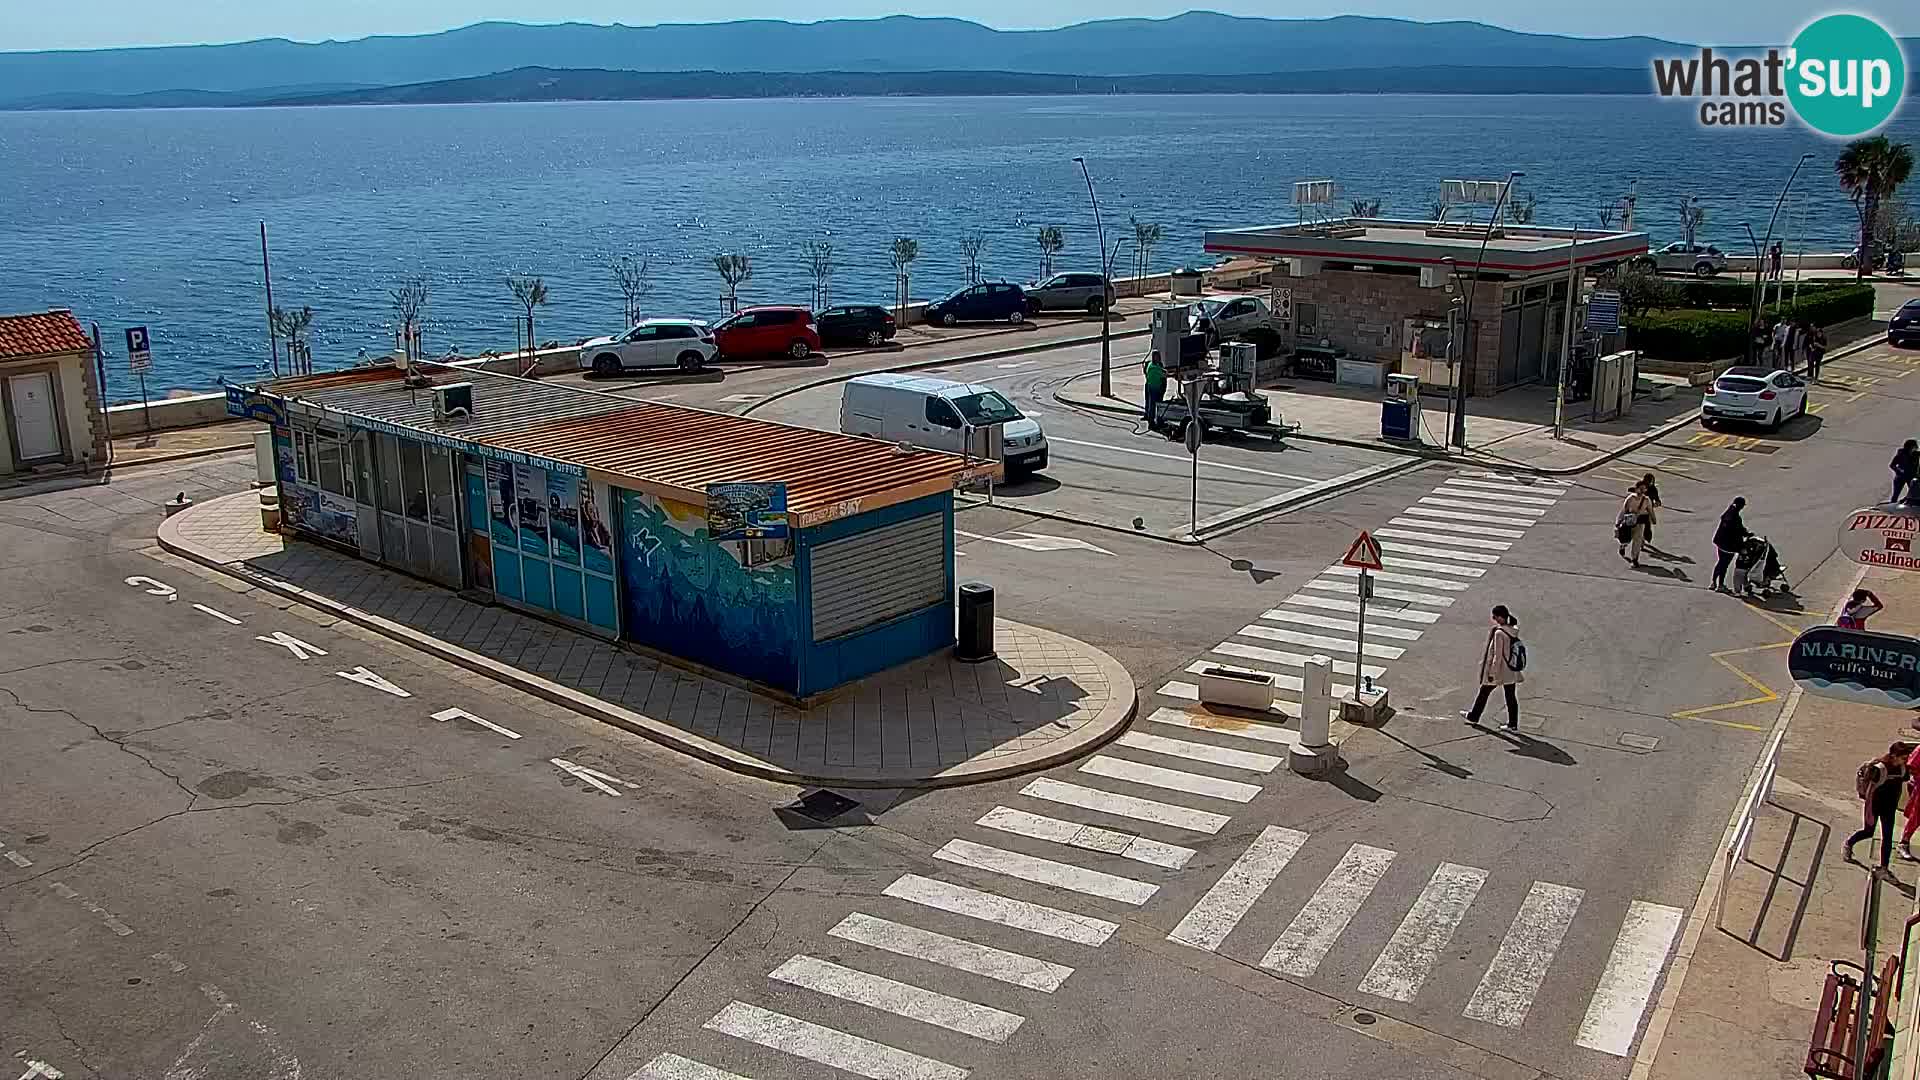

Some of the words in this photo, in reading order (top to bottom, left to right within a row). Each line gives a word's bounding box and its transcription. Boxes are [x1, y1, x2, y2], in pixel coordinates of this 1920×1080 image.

[131, 331, 143, 349] P
[1687, 431, 1761, 451] TAXI
[437, 435, 468, 452] POSTAJA
[478, 445, 494, 457] BUS
[495, 448, 527, 464] STATION
[528, 456, 554, 471] TICKET
[556, 463, 583, 477] OFFICE
[1848, 515, 1920, 532] PIZZE
[1882, 530, 1917, 540] GRILL
[1801, 642, 1920, 673] MARINER
[1829, 661, 1867, 675] caffe
[1871, 665, 1897, 680] bar
